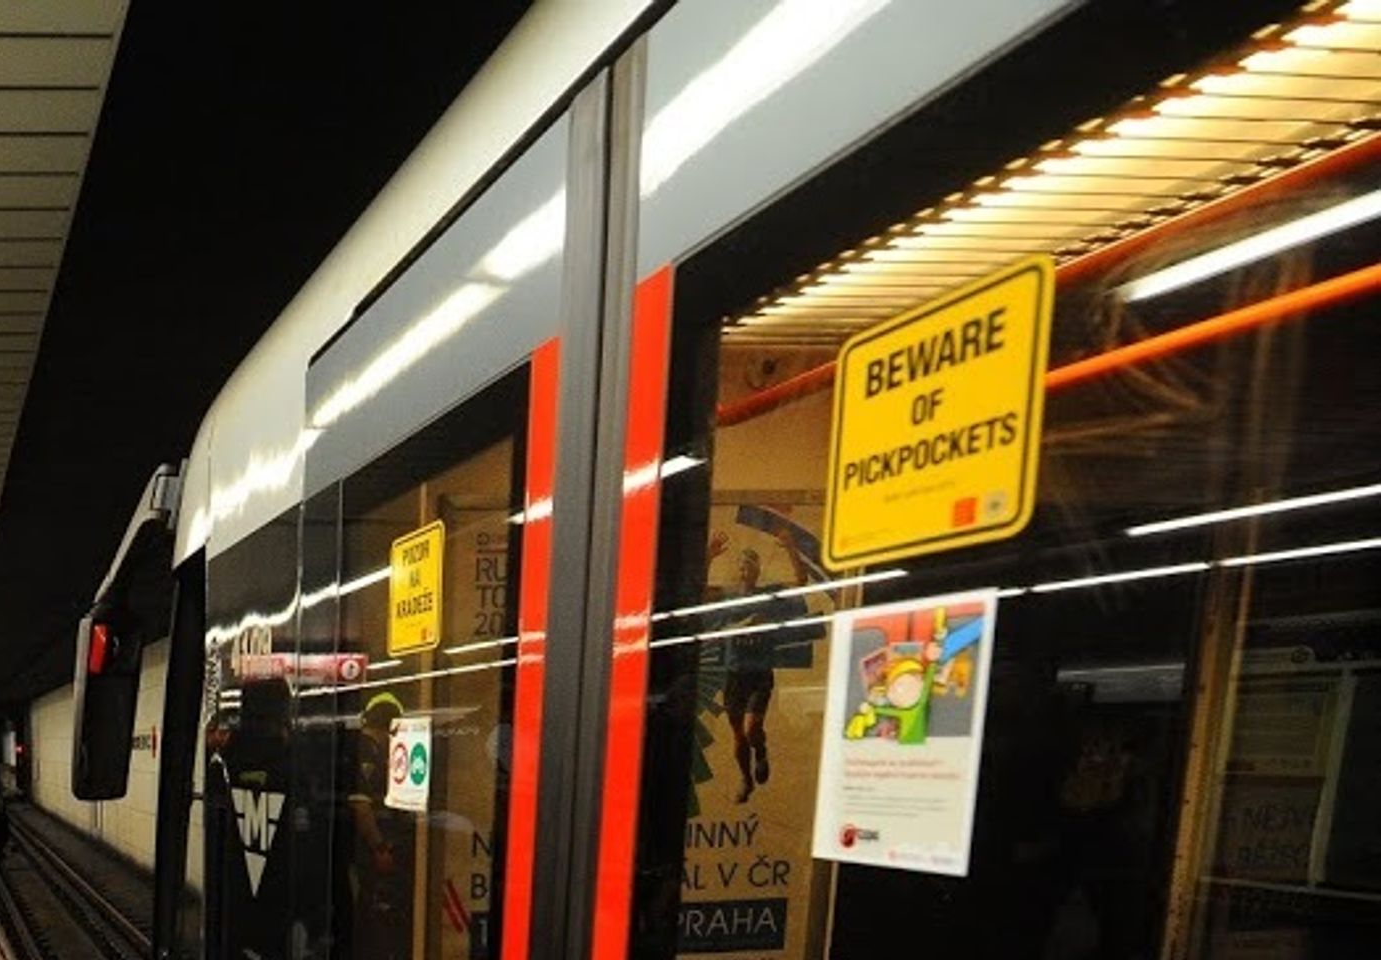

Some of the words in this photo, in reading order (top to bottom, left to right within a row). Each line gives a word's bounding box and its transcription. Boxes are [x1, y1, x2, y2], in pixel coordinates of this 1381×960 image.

[865, 307, 1008, 399] BEWARE
[911, 388, 945, 427] OF
[842, 411, 1019, 492] PICKPOCKETS
[717, 862, 738, 888] V
[747, 854, 791, 888] ČR
